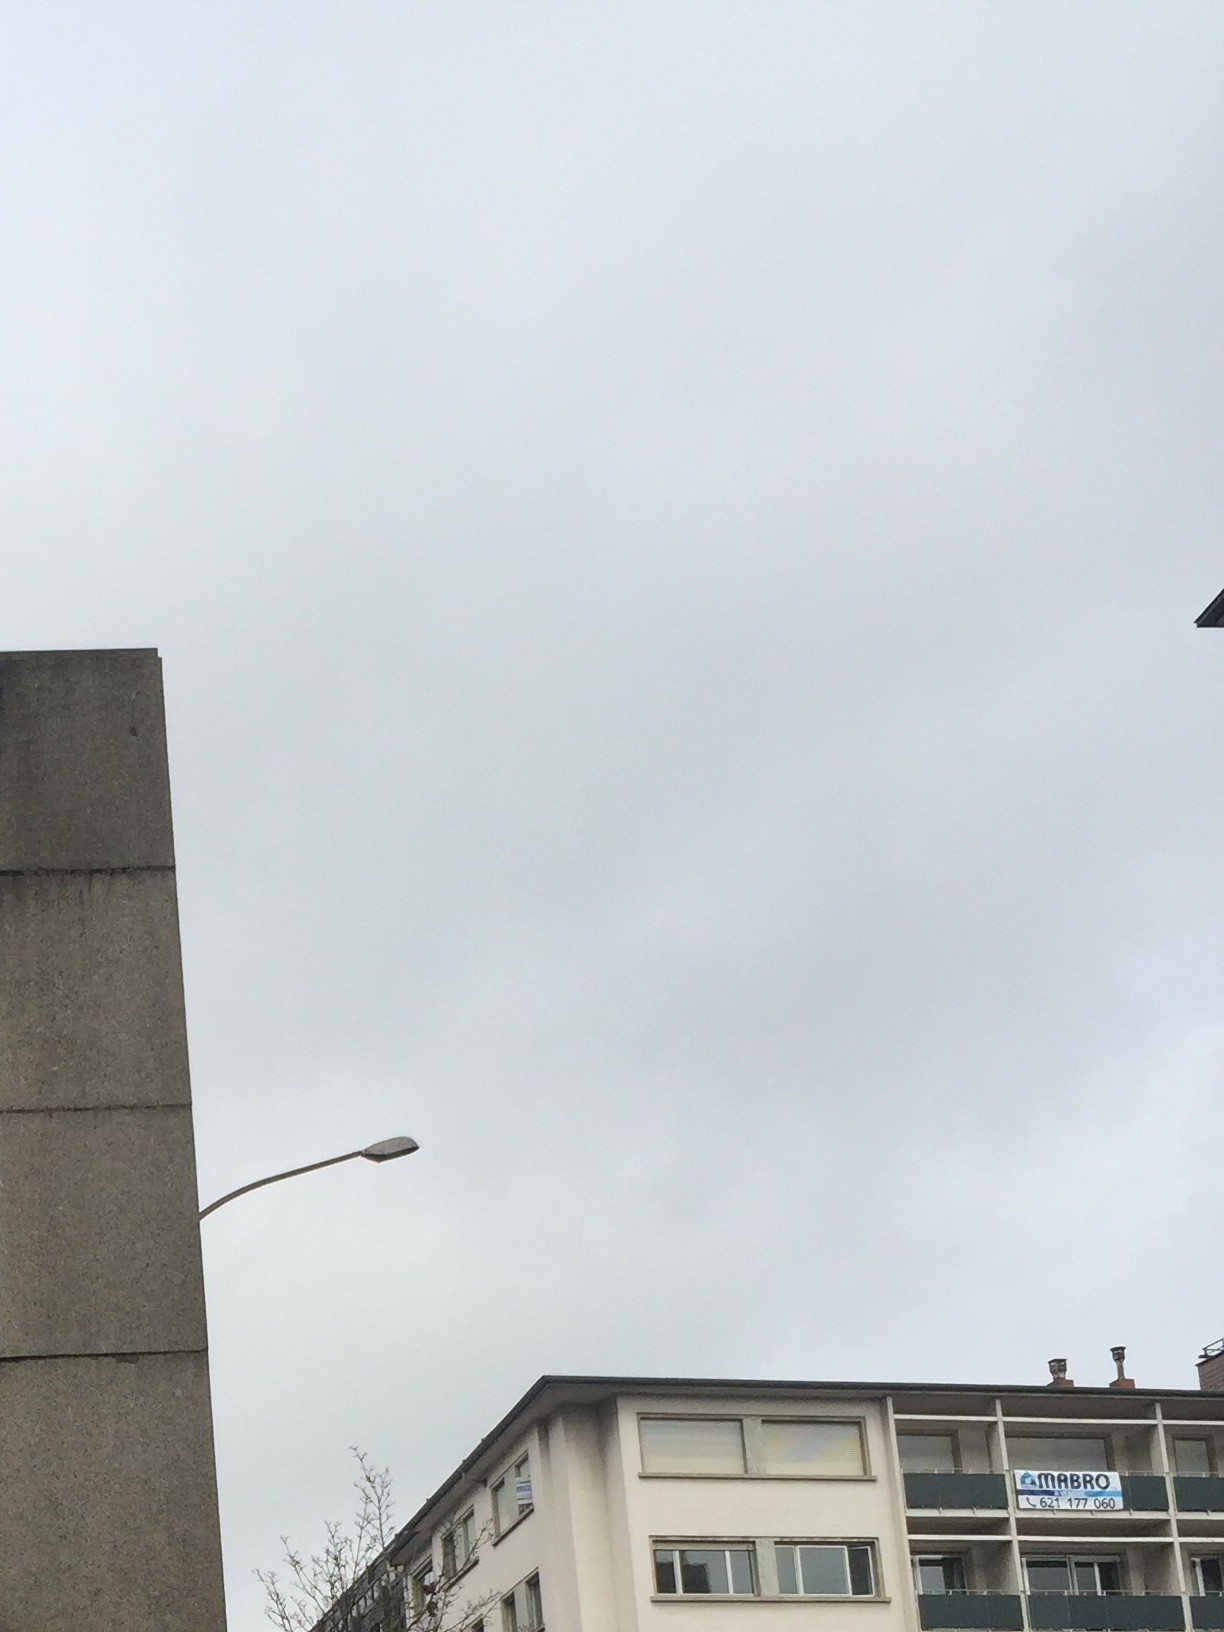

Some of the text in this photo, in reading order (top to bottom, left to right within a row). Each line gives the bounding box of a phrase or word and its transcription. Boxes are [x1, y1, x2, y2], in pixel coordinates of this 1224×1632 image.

[1037, 1472, 1111, 1490] MABRO
[1039, 1496, 1116, 1510] 621 177 060
